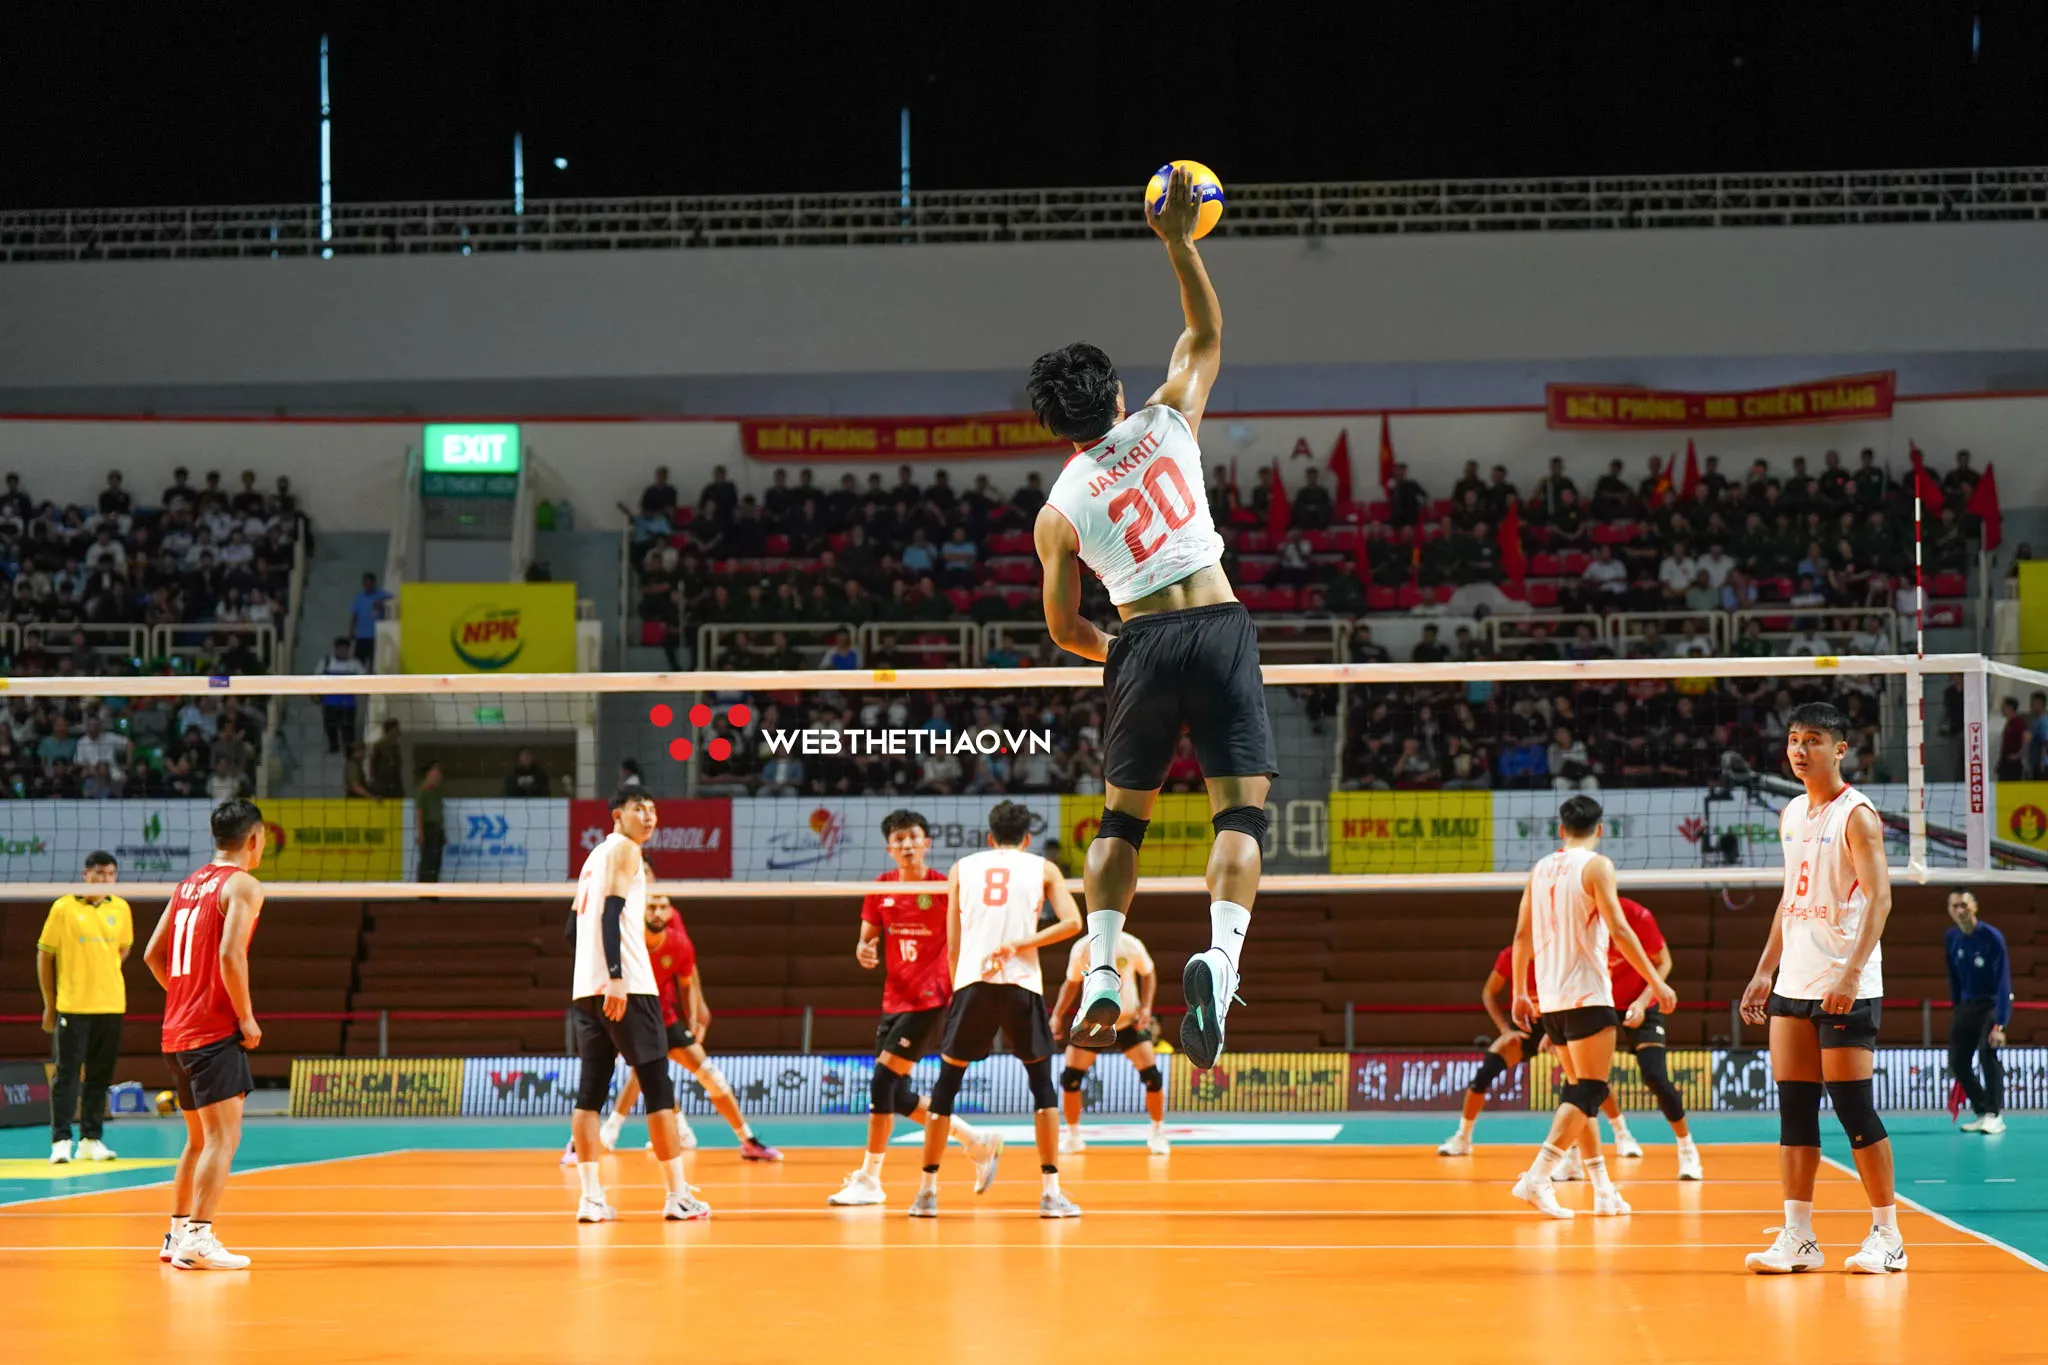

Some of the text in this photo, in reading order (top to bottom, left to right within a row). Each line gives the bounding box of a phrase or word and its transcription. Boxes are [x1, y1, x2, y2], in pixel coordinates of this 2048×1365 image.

[443, 434, 507, 464] EXIT
[1087, 431, 1160, 497] JAKKRIT
[1108, 456, 1196, 564] 20
[463, 617, 519, 645] NPK
[1342, 818, 1390, 838] NPK
[983, 868, 1011, 906] 8
[1796, 861, 1809, 896] 6
[172, 906, 200, 977] 11
